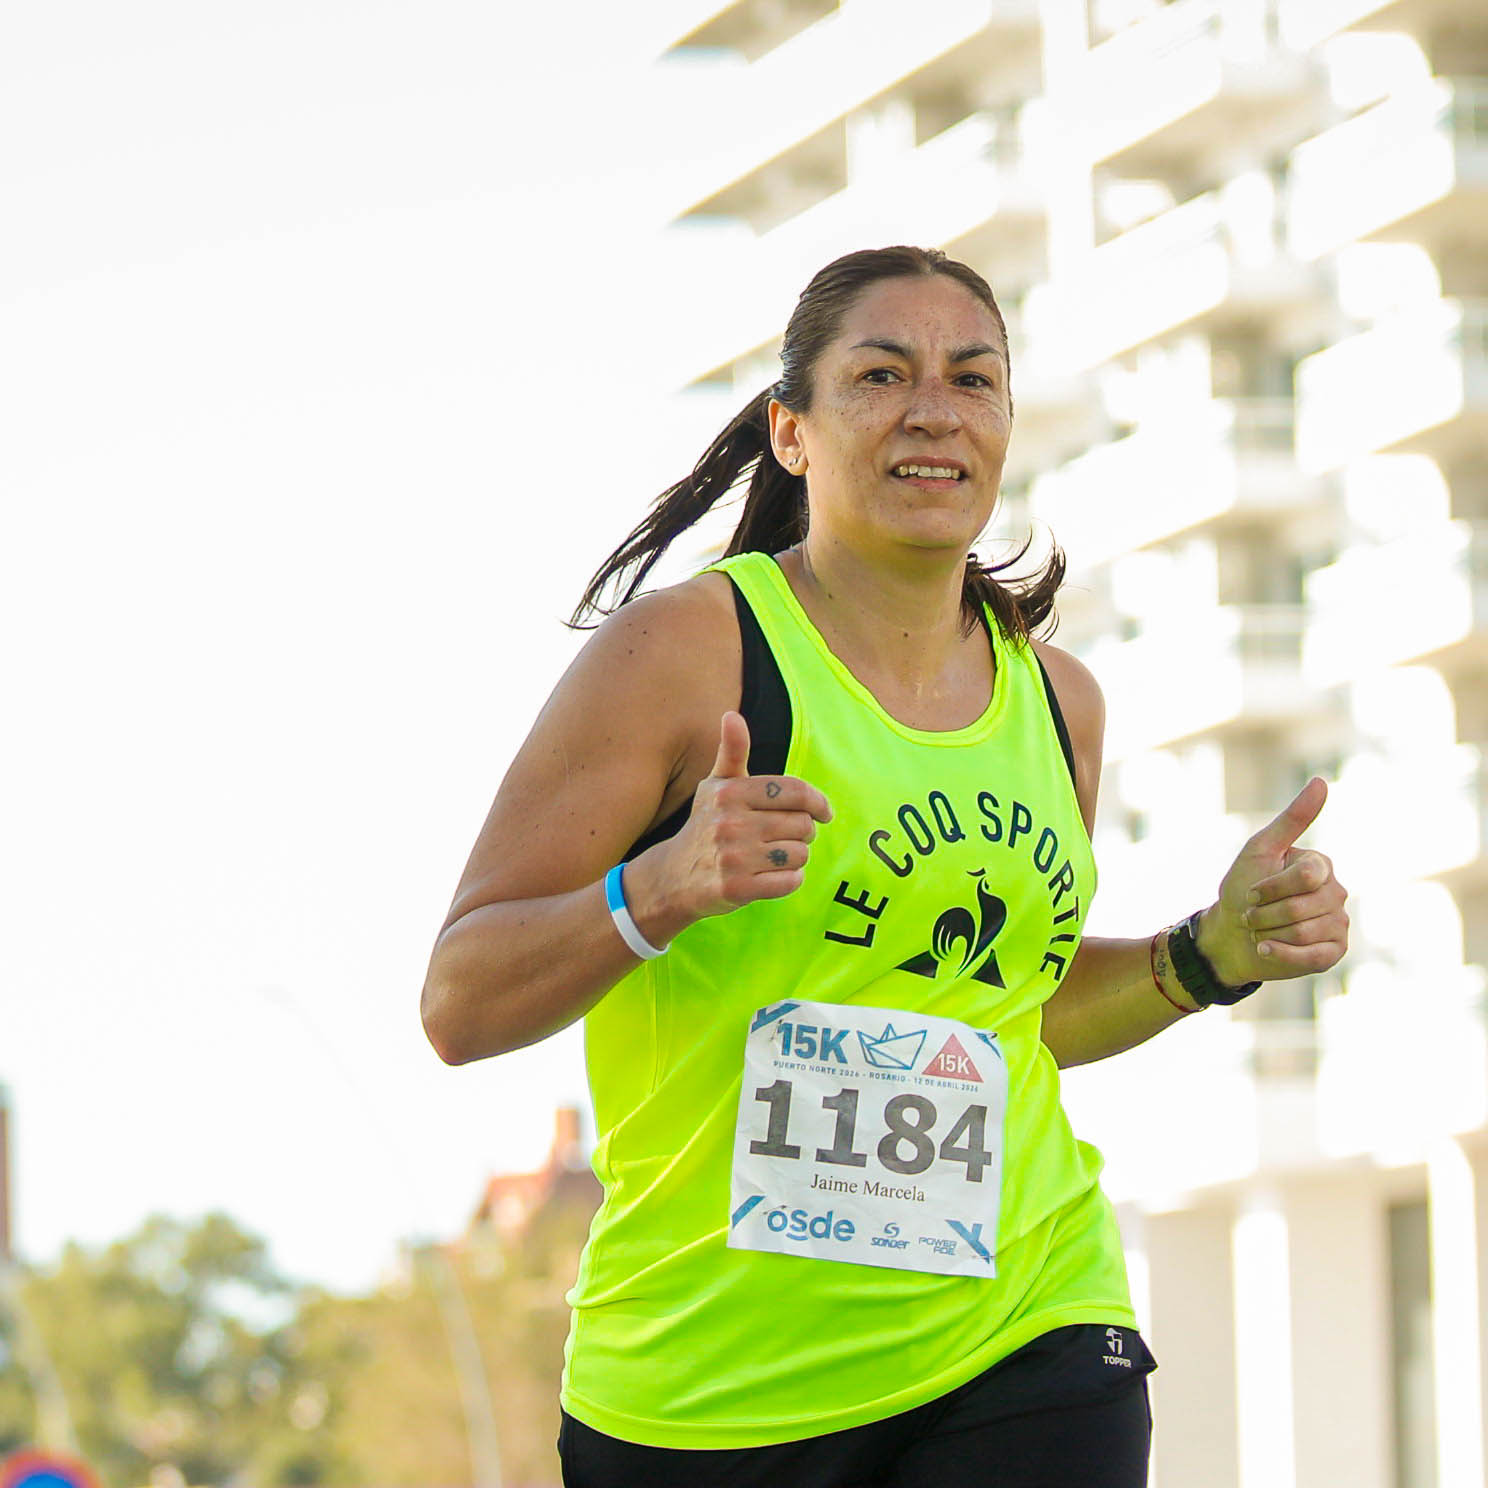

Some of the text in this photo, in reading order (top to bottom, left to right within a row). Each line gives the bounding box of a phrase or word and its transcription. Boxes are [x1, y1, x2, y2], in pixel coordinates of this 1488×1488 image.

[824, 880, 889, 948] LE
[869, 790, 966, 878] COQ
[778, 1022, 851, 1064] 15K
[773, 1060, 806, 1071] PUERTO
[809, 1065, 837, 1075] NORTE
[869, 1072, 906, 1082] ROSARIO
[937, 1081, 959, 1090] ABRIL
[936, 1051, 971, 1075] 15K
[749, 1079, 992, 1183] 1184
[810, 1173, 925, 1202] Jaime Marcela
[767, 1209, 855, 1241] osde
[1102, 1355, 1132, 1369] TOPPER
